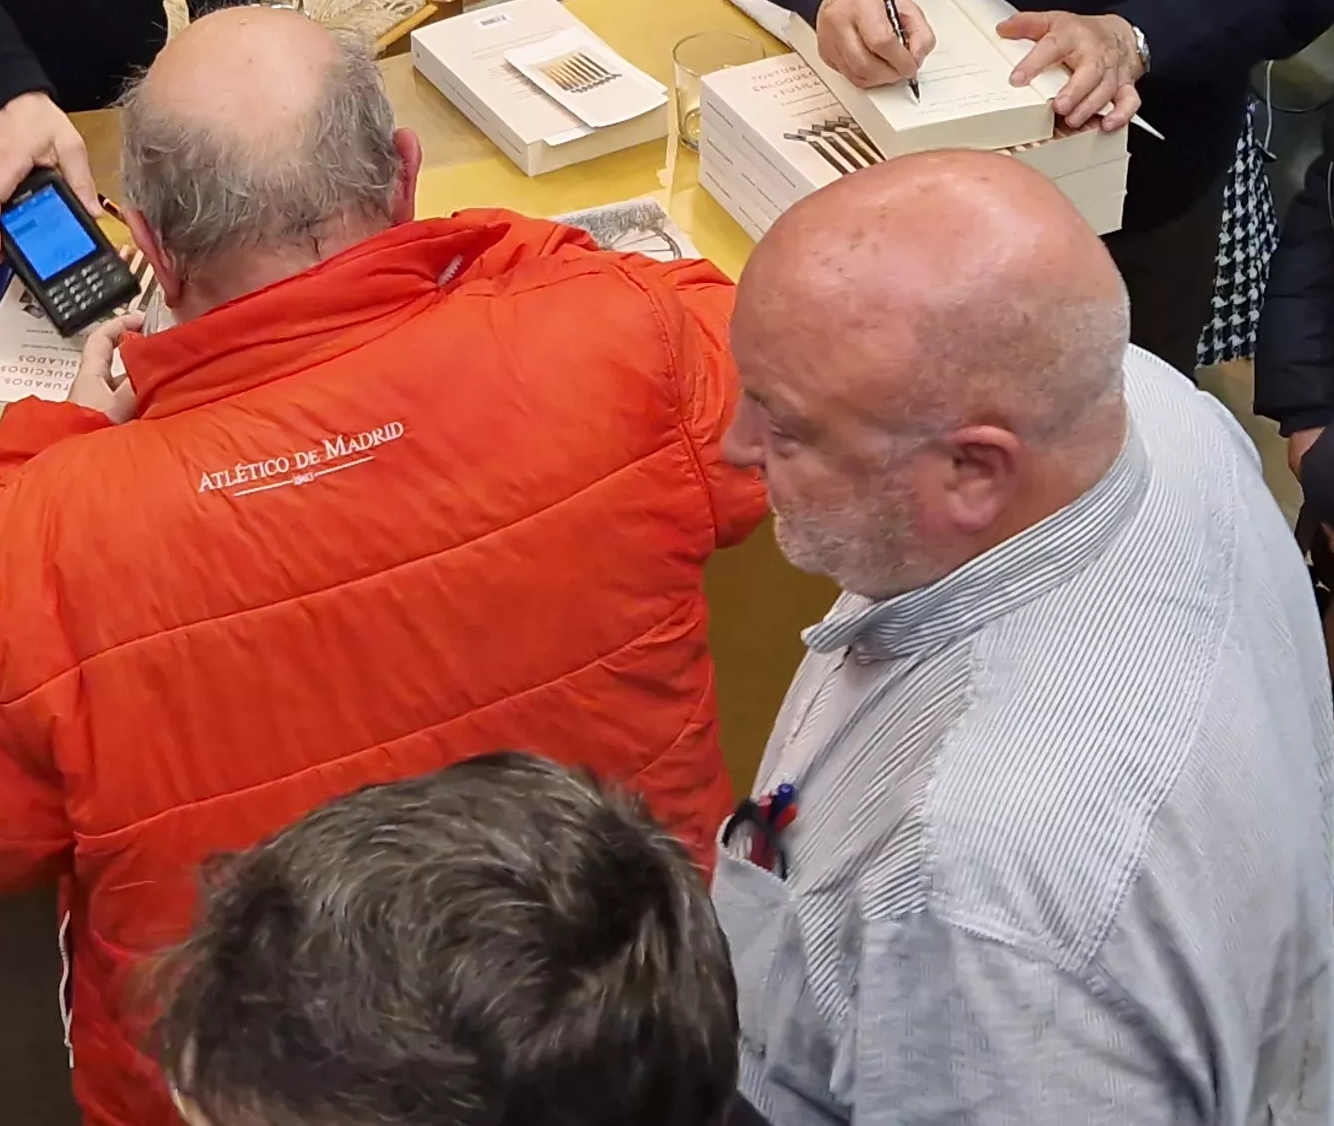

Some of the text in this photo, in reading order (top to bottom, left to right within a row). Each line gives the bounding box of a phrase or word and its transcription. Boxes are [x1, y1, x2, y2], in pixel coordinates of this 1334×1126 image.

[19, 354, 78, 368] SILADOS
[0, 364, 76, 380] QUECIDOS
[198, 421, 405, 493] ATLÉTICO DE MADRID
